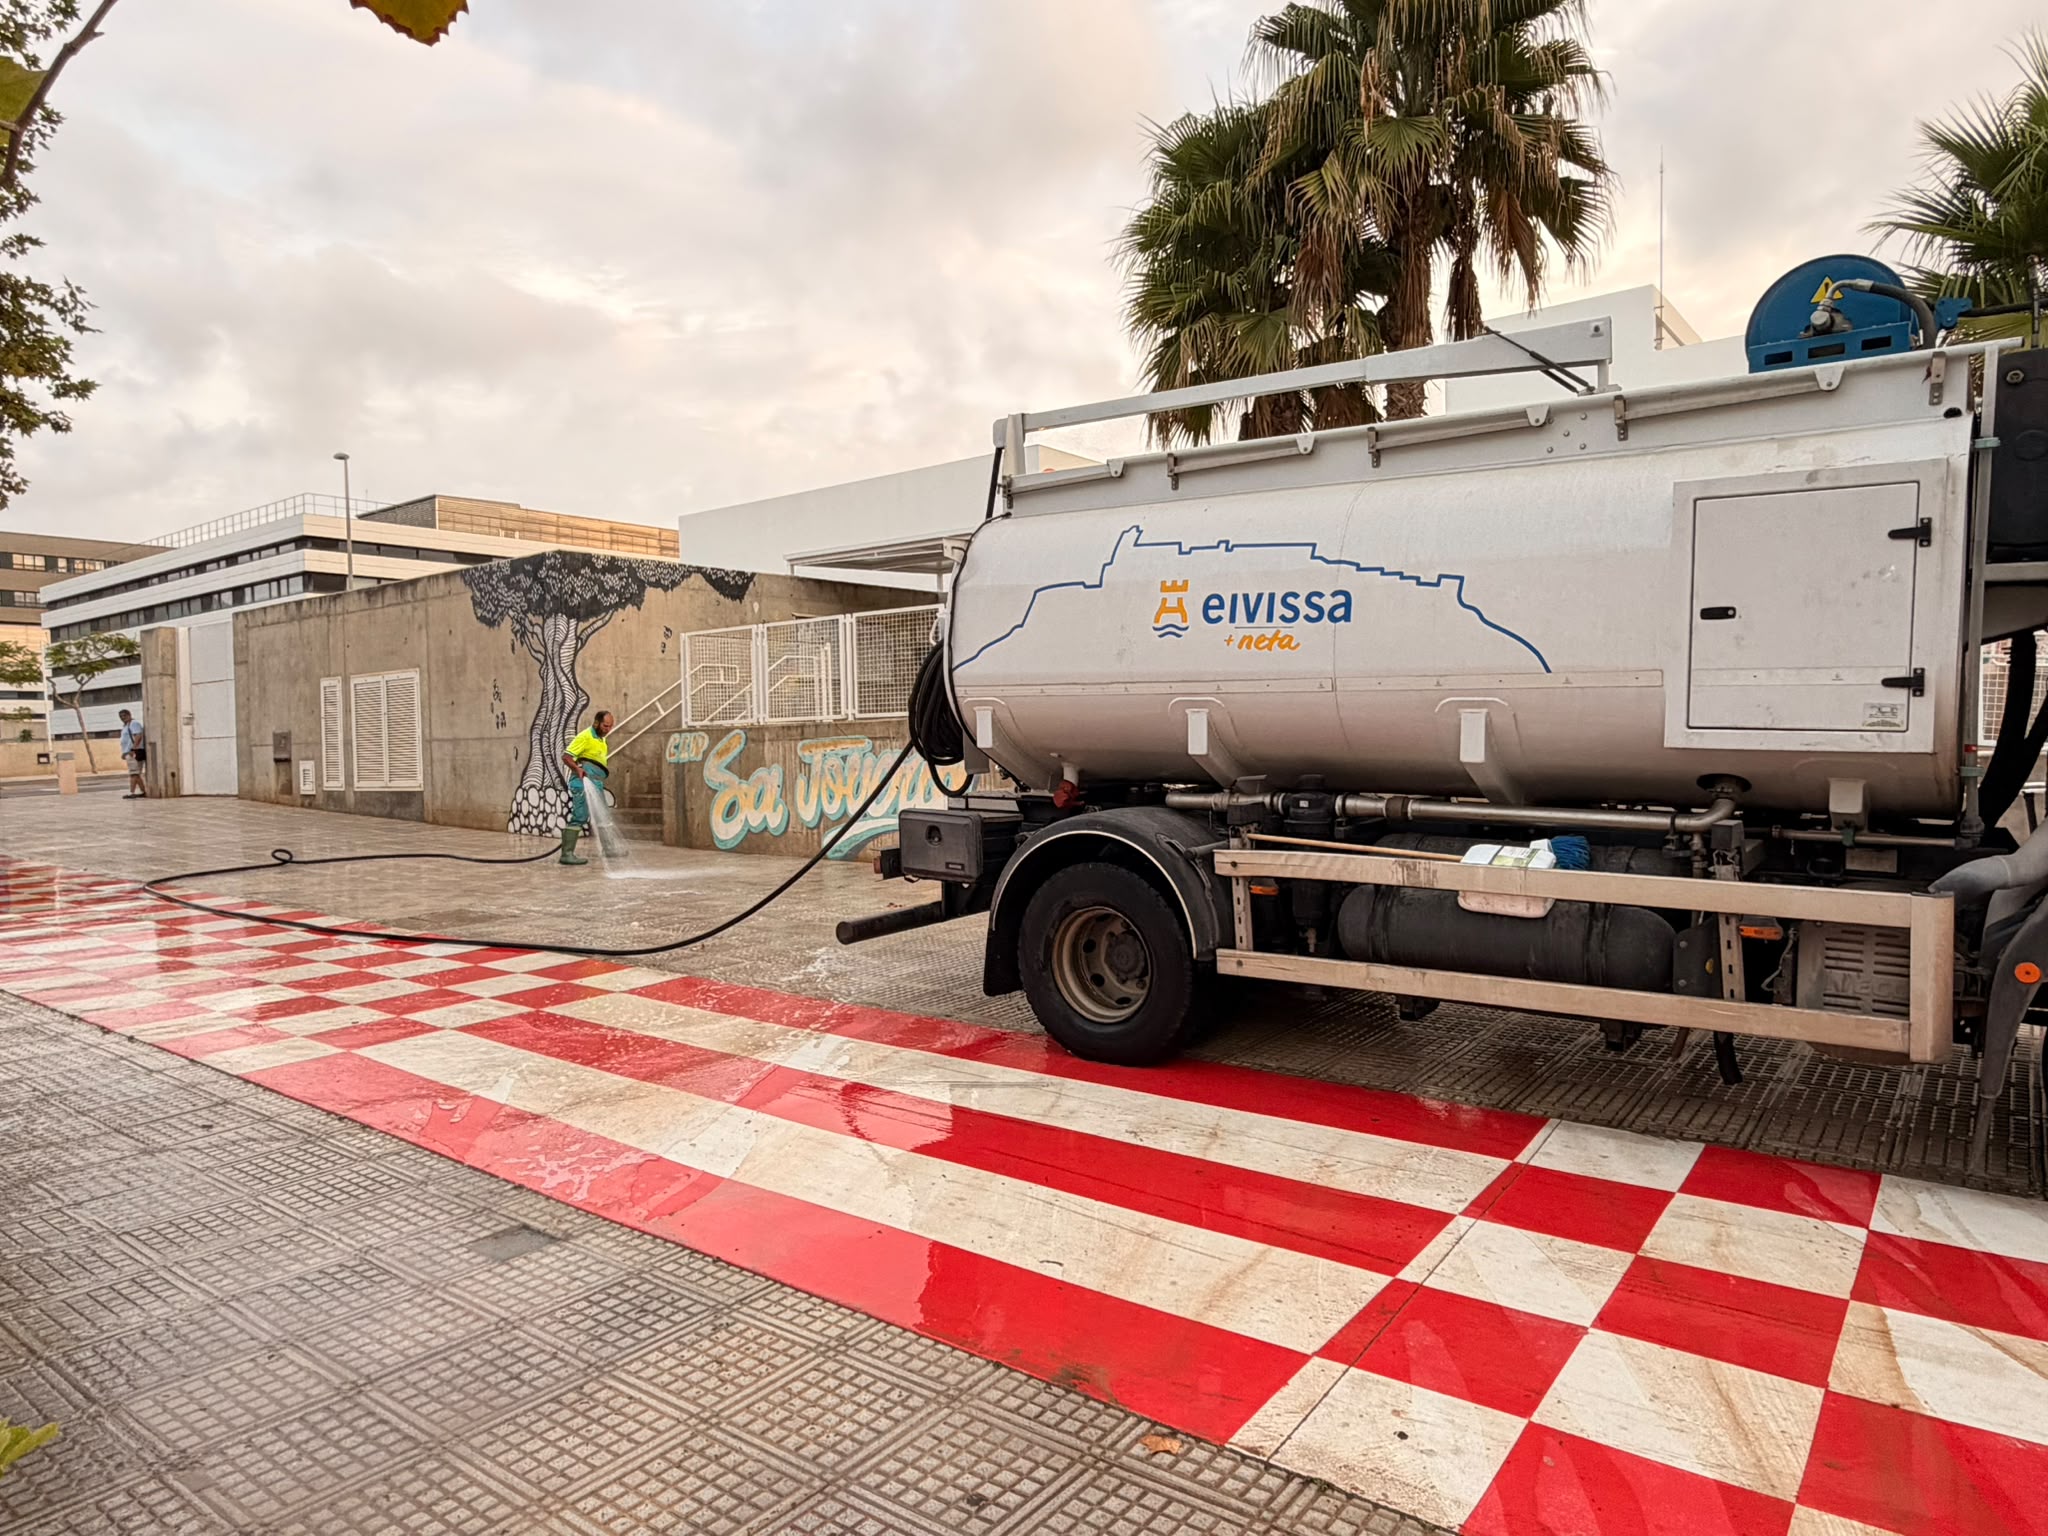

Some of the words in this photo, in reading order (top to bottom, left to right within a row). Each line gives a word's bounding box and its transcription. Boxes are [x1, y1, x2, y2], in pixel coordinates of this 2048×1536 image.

[1202, 589, 1352, 624] eivissa
[1237, 629, 1301, 651] neta
[704, 729, 789, 850] Sa
